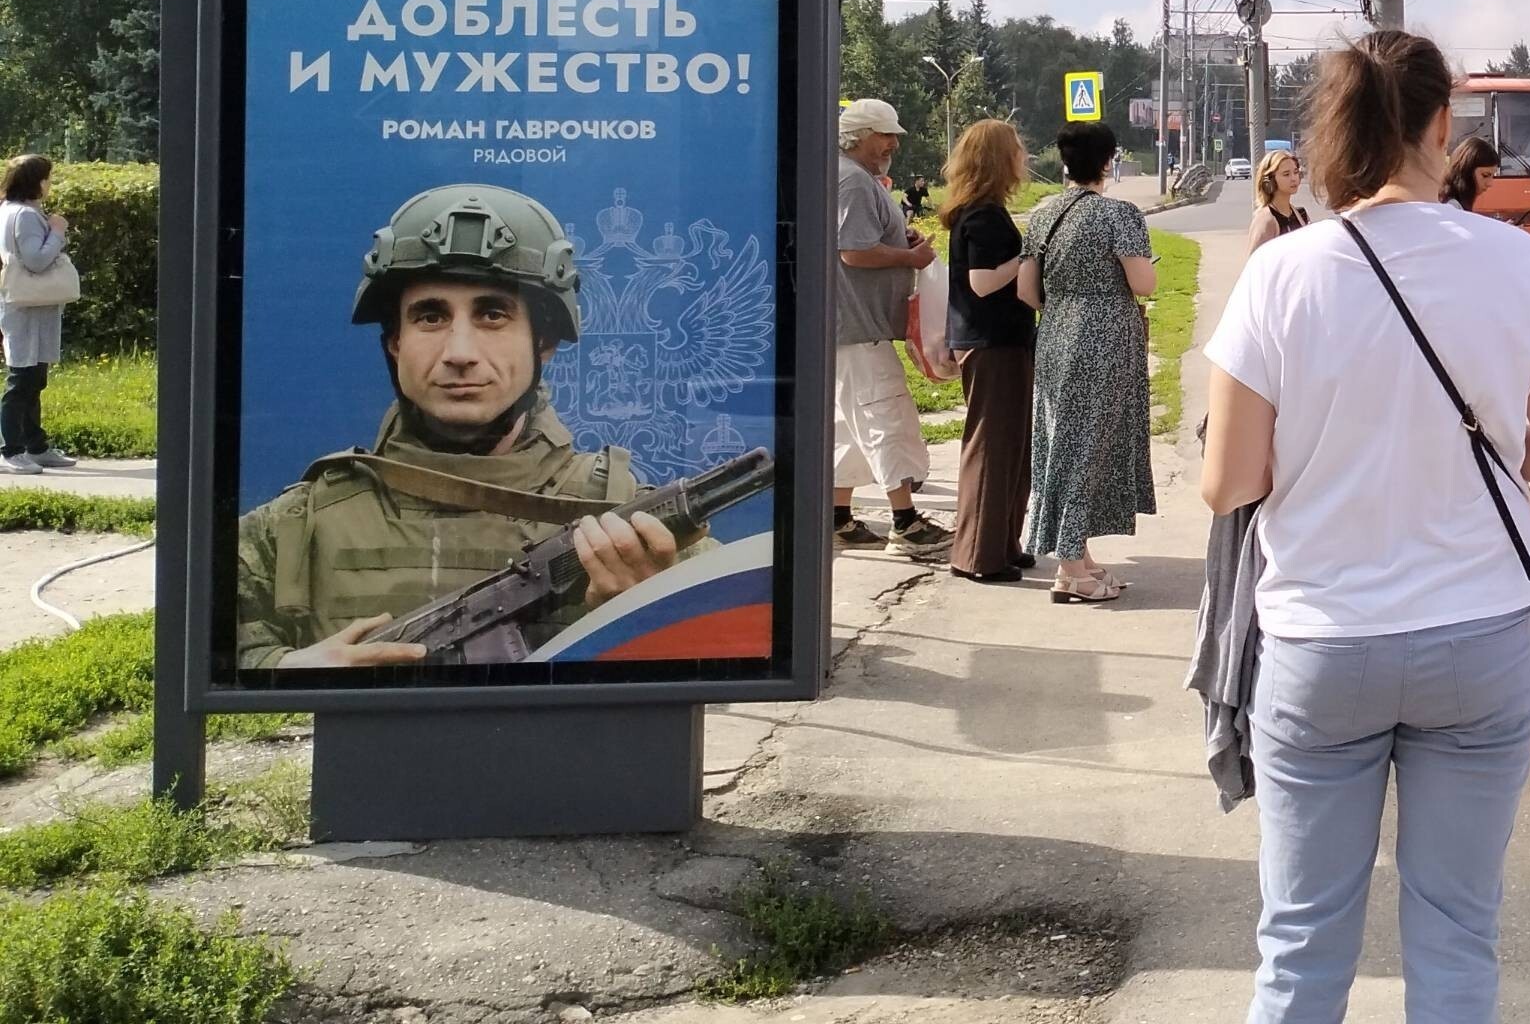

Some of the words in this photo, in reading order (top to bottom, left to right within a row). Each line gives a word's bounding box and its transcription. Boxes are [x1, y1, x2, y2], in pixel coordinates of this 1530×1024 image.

[289, 51, 330, 93] И
[360, 51, 752, 94] МУЖЕСТВО!
[382, 120, 486, 140] РОМАН
[495, 120, 656, 142] ГАВРОЧКОВ
[473, 144, 567, 164] РЯДОВОЙ
